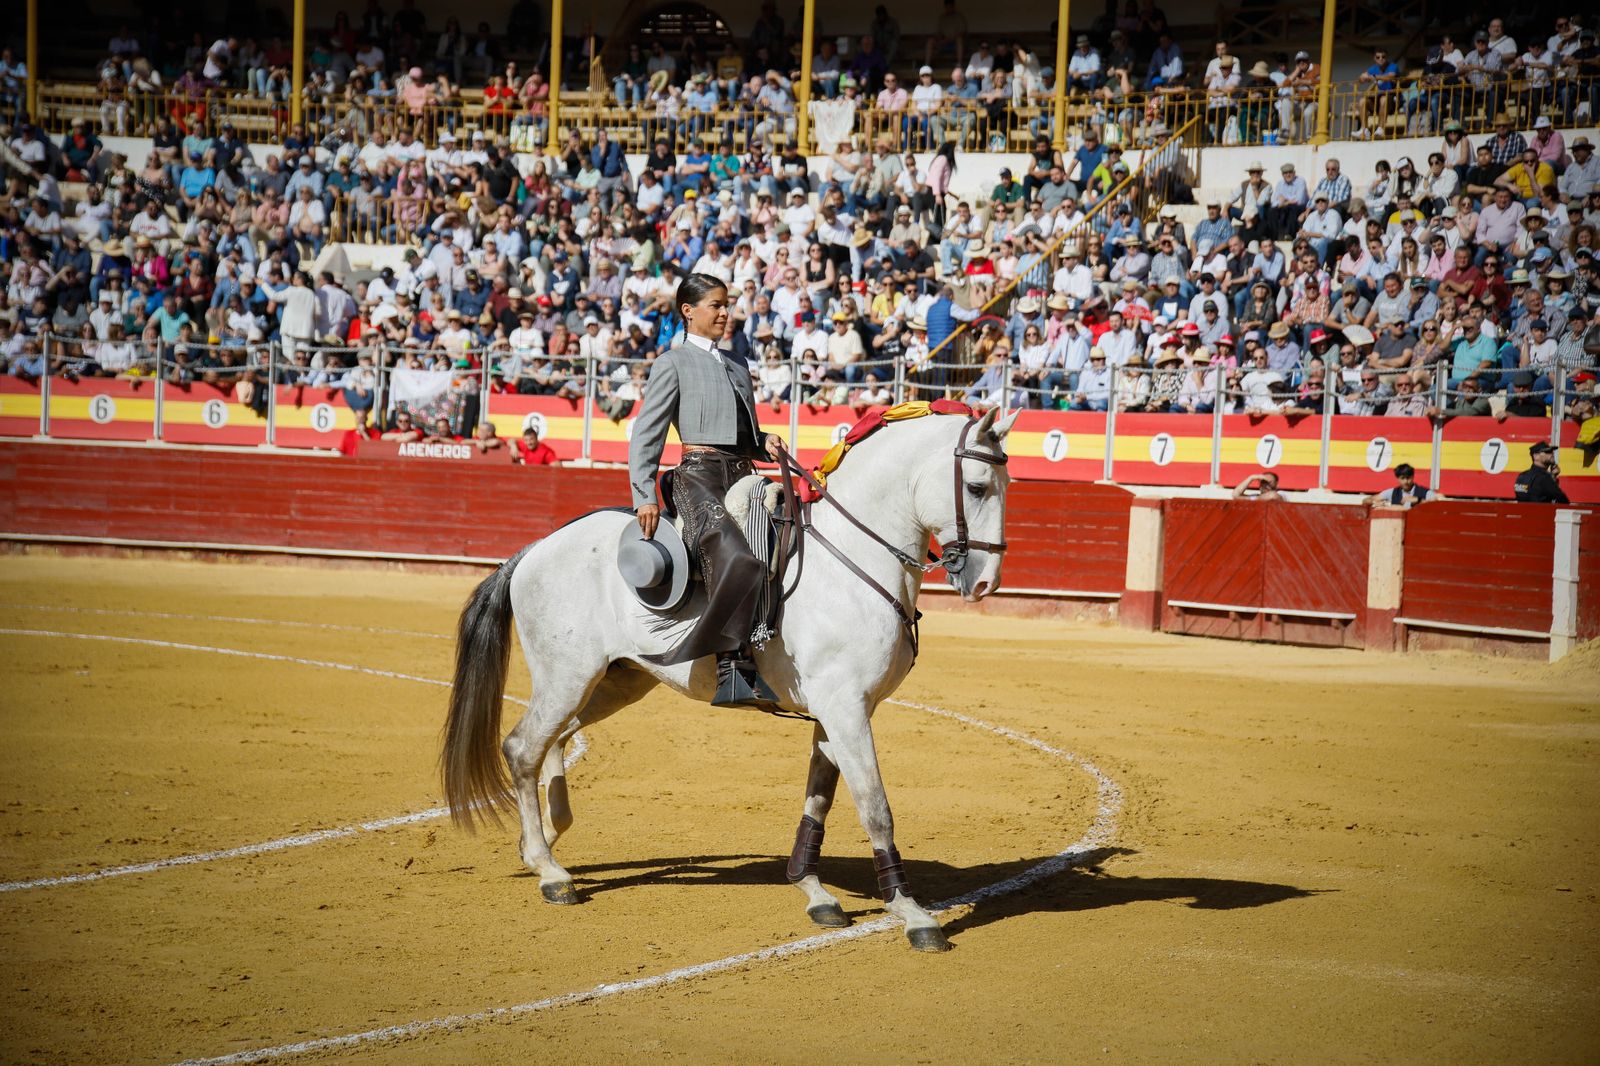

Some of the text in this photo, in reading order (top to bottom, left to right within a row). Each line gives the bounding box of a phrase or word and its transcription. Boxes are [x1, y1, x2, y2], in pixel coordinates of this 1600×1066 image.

[96, 398, 108, 420] 6
[208, 402, 221, 424] 6
[316, 406, 328, 429] 6
[529, 416, 540, 436] 6
[398, 442, 471, 459] ARENEROS
[1050, 434, 1061, 458] 7
[1157, 437, 1168, 463] 7
[1264, 439, 1275, 464] 7
[1374, 441, 1386, 468] 7
[1489, 442, 1501, 470] 7
